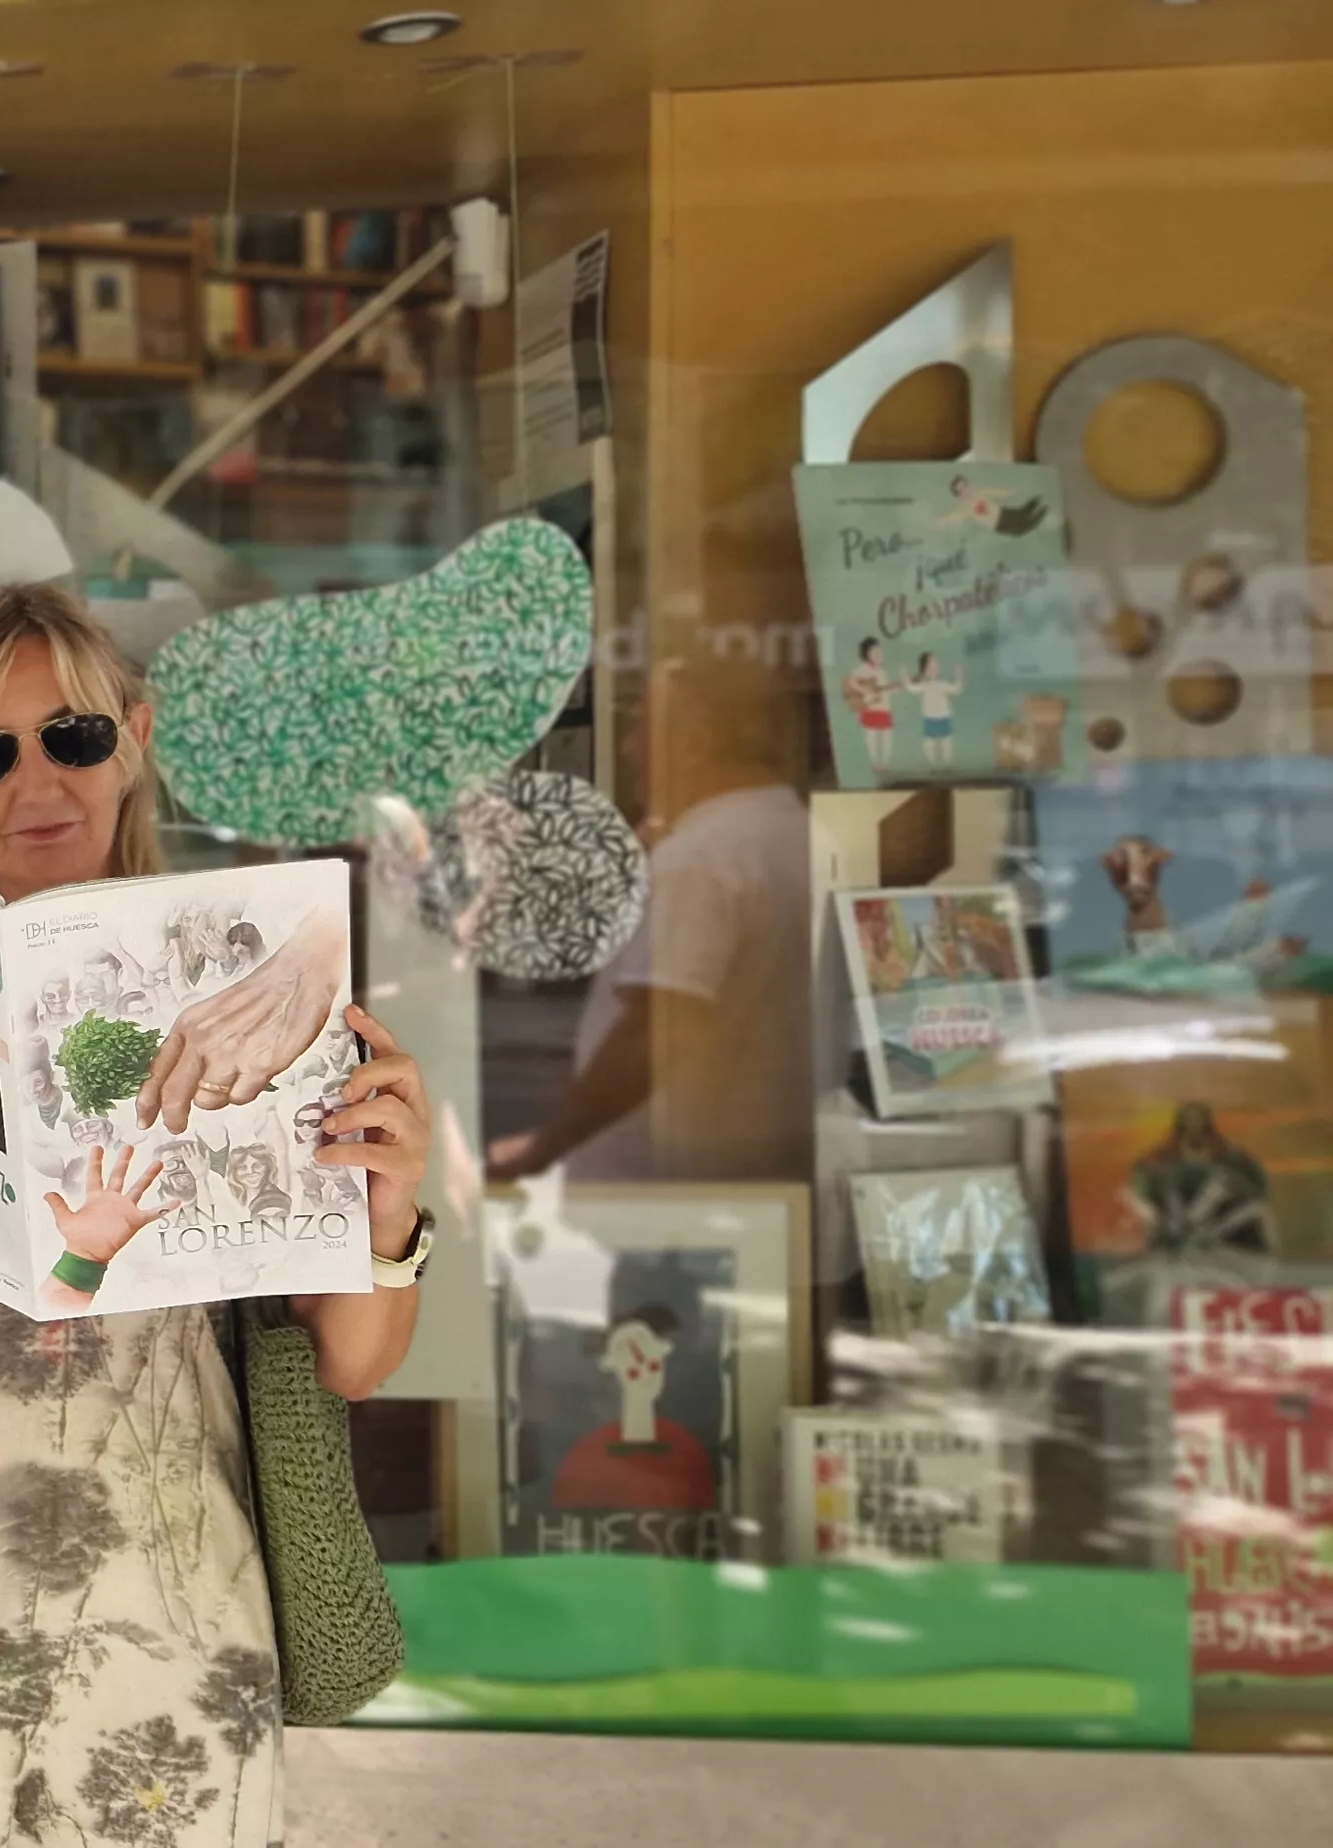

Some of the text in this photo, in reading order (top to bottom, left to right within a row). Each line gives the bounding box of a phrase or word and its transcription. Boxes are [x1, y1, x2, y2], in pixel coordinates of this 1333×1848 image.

[157, 1204, 217, 1230] SAN
[157, 1212, 350, 1257] LORENZO
[321, 1240, 348, 1250] 2024
